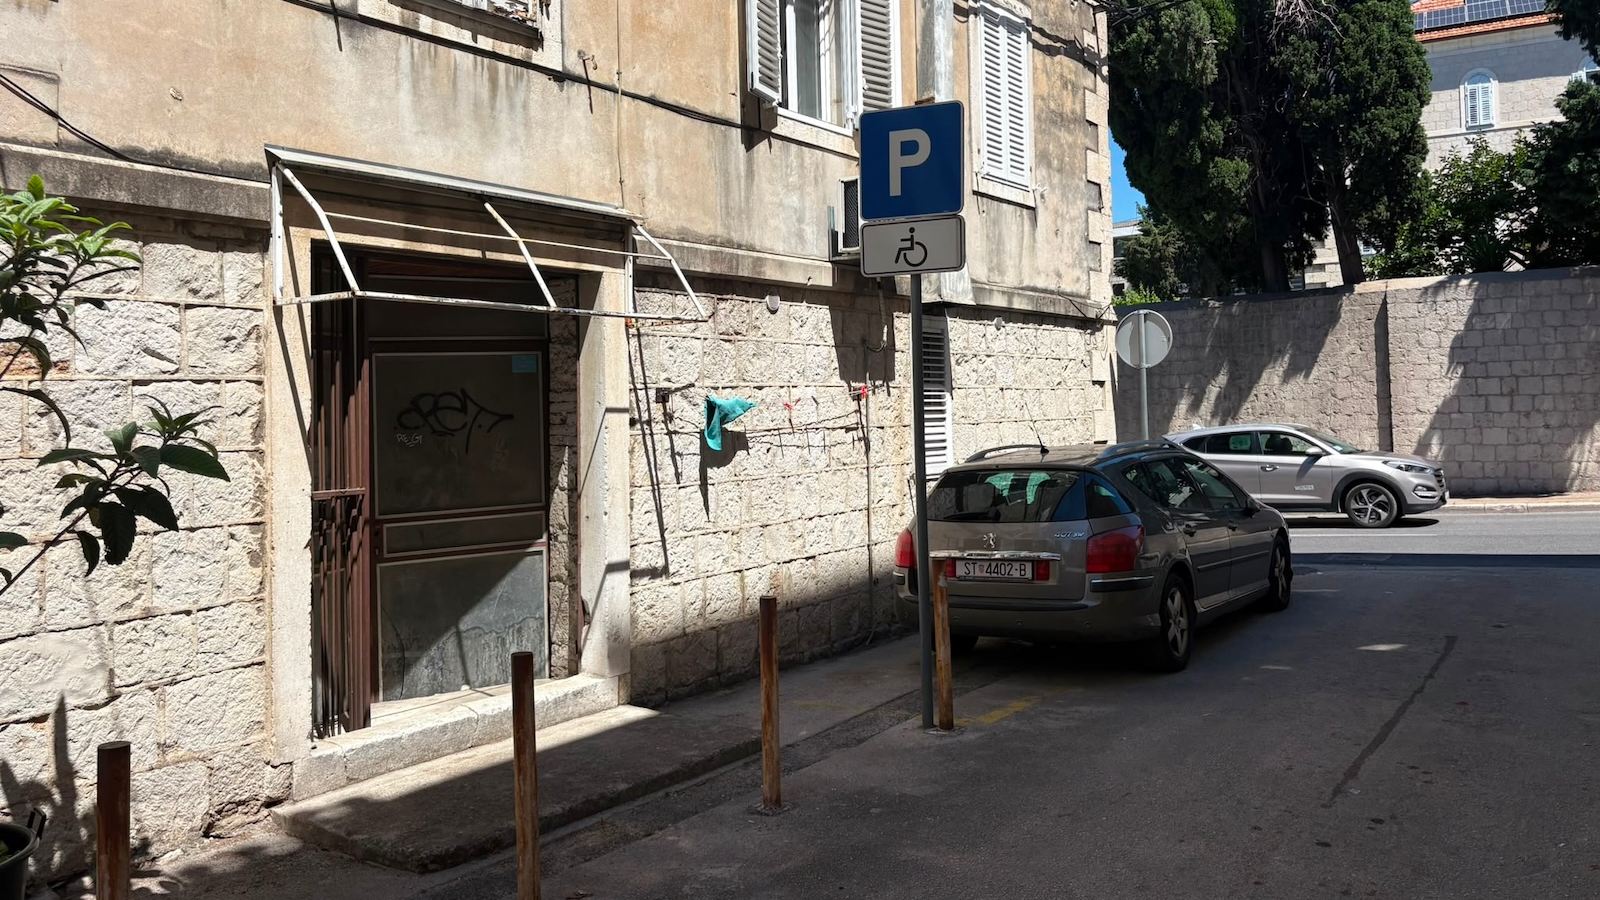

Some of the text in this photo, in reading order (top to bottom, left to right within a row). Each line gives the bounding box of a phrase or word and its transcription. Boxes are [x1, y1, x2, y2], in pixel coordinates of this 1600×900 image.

[888, 128, 931, 197] P
[964, 562, 1027, 577] ST 4402-B
